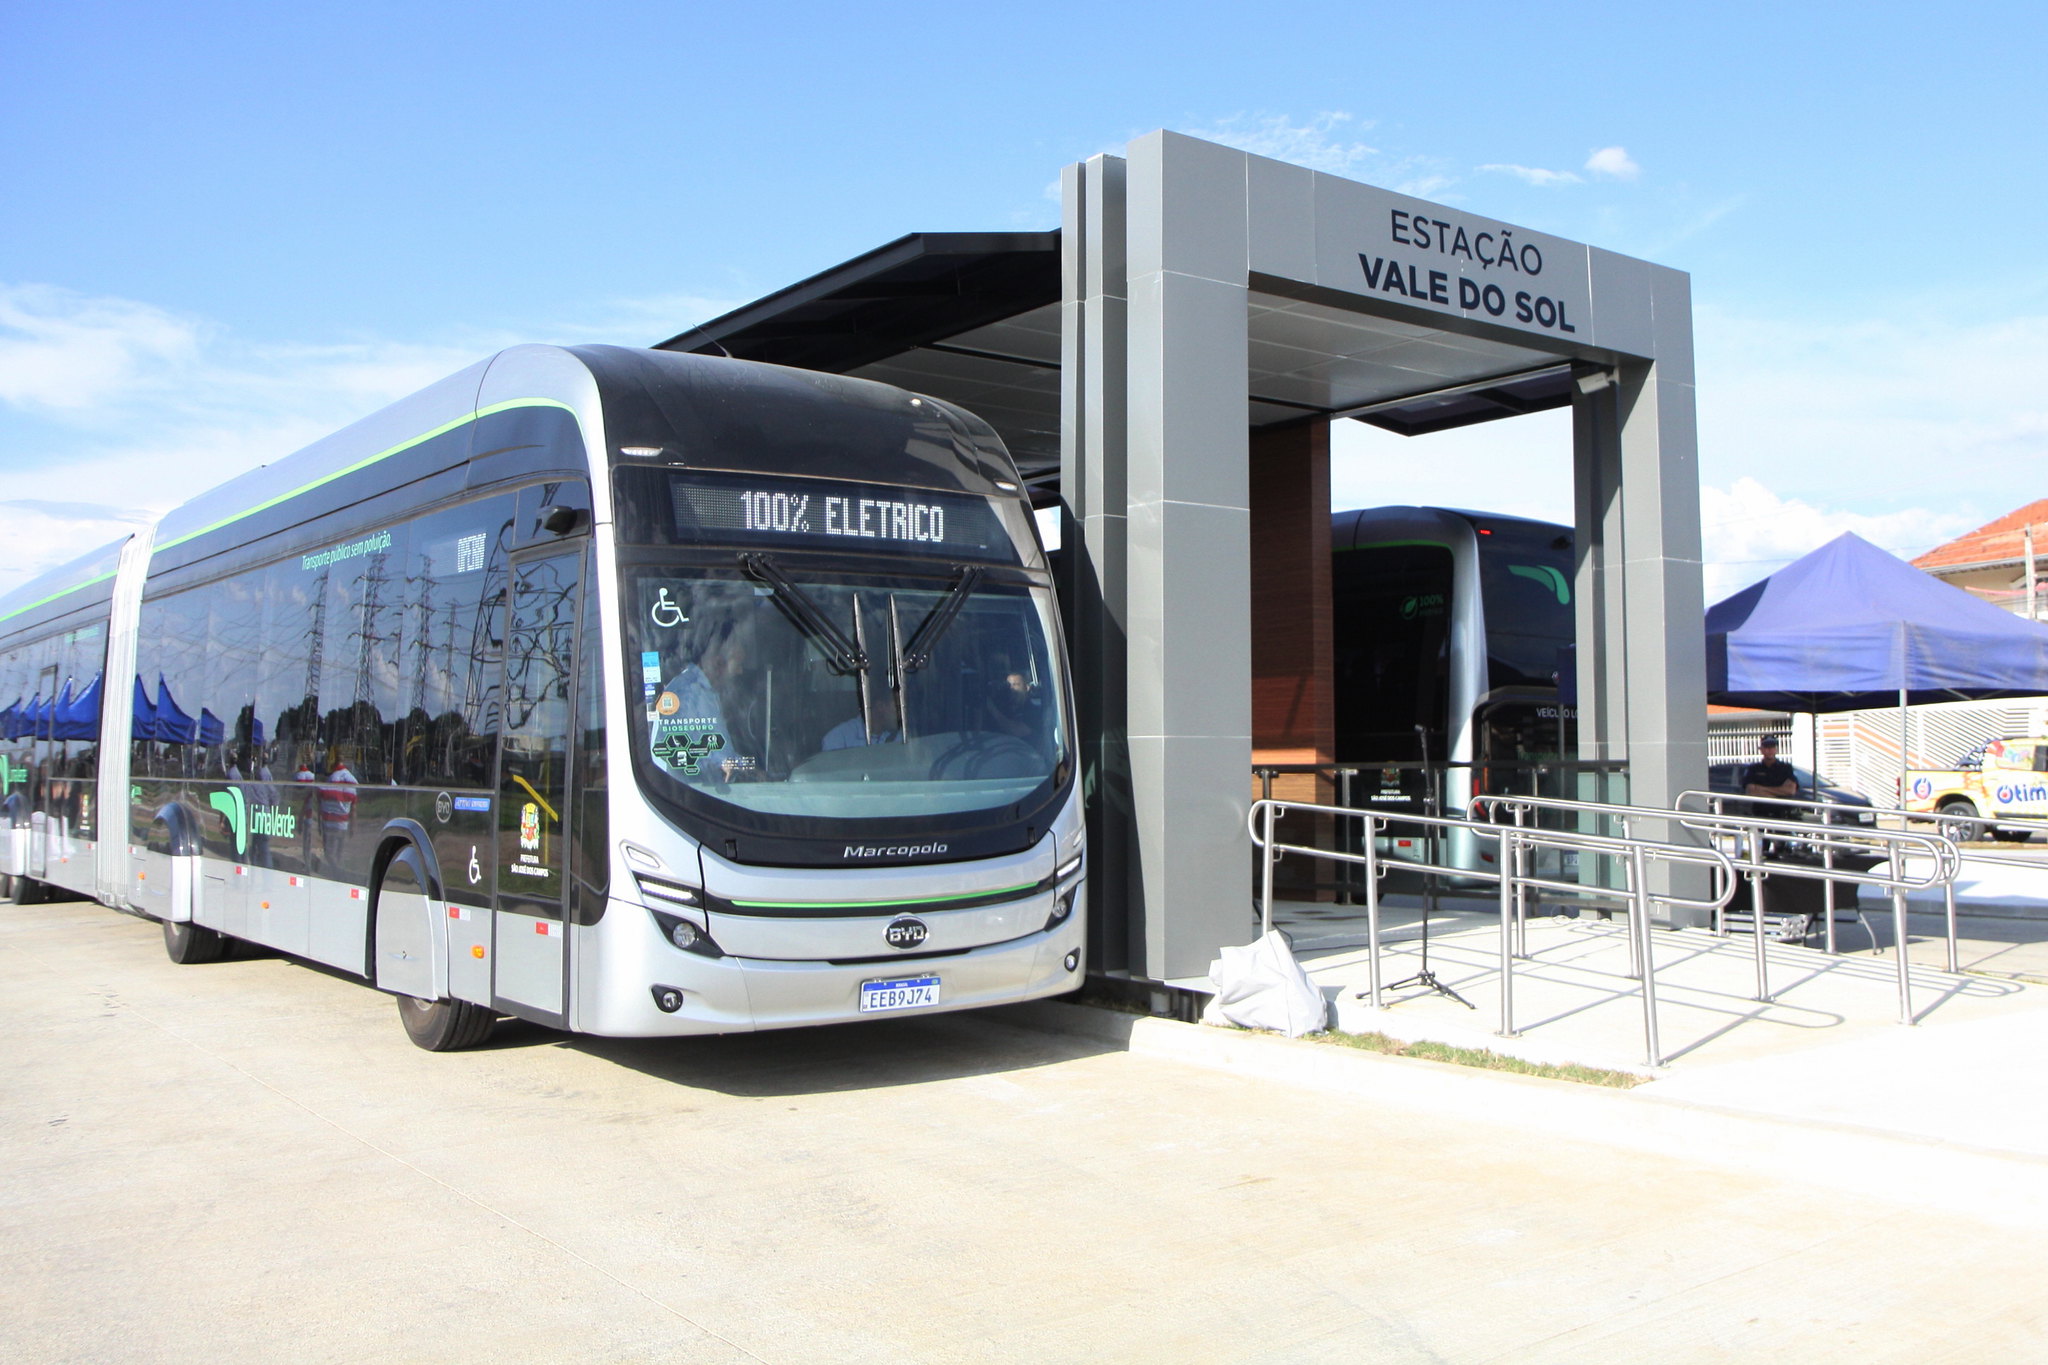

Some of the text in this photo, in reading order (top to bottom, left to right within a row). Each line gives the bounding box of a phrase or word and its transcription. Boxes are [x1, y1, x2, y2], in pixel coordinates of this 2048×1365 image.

[1391, 209, 1543, 276] ESTAÇÃO
[1358, 253, 1576, 333] VALE DO SOL
[741, 490, 944, 543] 100% ELETRICO
[302, 554, 331, 571] Transporte
[351, 541, 364, 558] sem
[659, 717, 718, 726] TRANSPORTE
[662, 724, 714, 732] BIOSEGURO
[844, 842, 948, 858] Marcopolo
[889, 925, 925, 942] BYD
[869, 988, 933, 1009] EEB9J74
